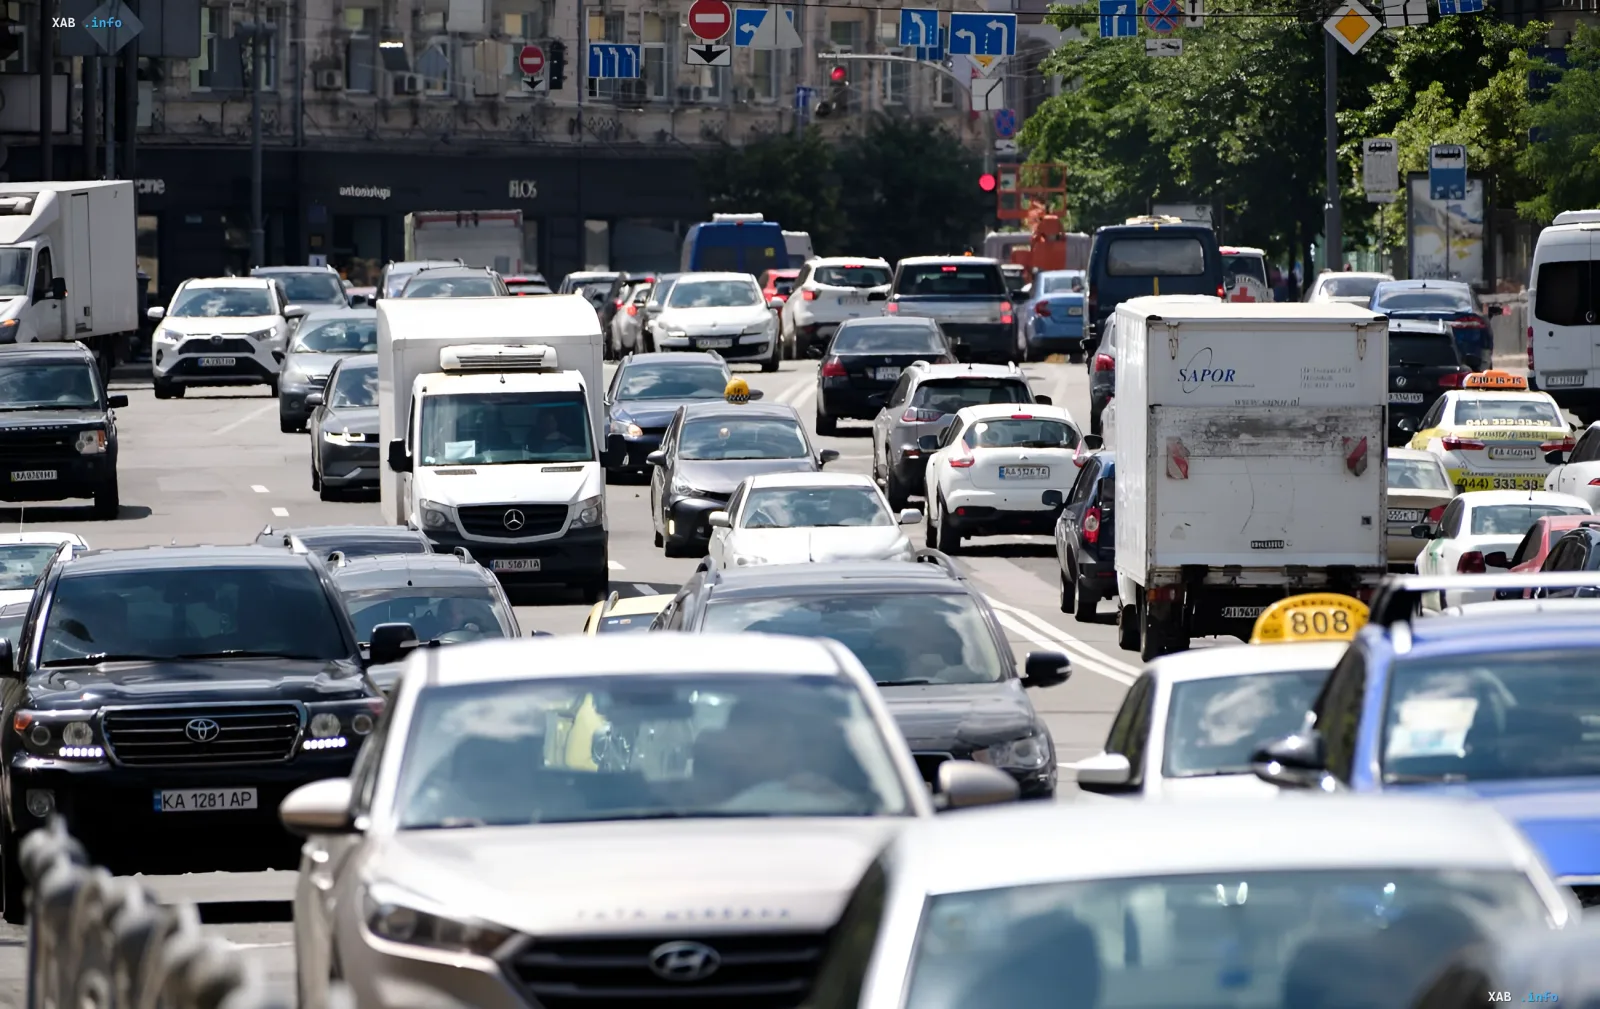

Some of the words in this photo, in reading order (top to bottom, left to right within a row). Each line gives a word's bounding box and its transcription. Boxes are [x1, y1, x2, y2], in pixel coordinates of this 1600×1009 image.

[1177, 368, 1236, 383] SAPOR
[1291, 610, 1349, 635] 808
[162, 793, 186, 809] KA
[191, 793, 225, 808] 1281
[230, 791, 252, 807] AP
